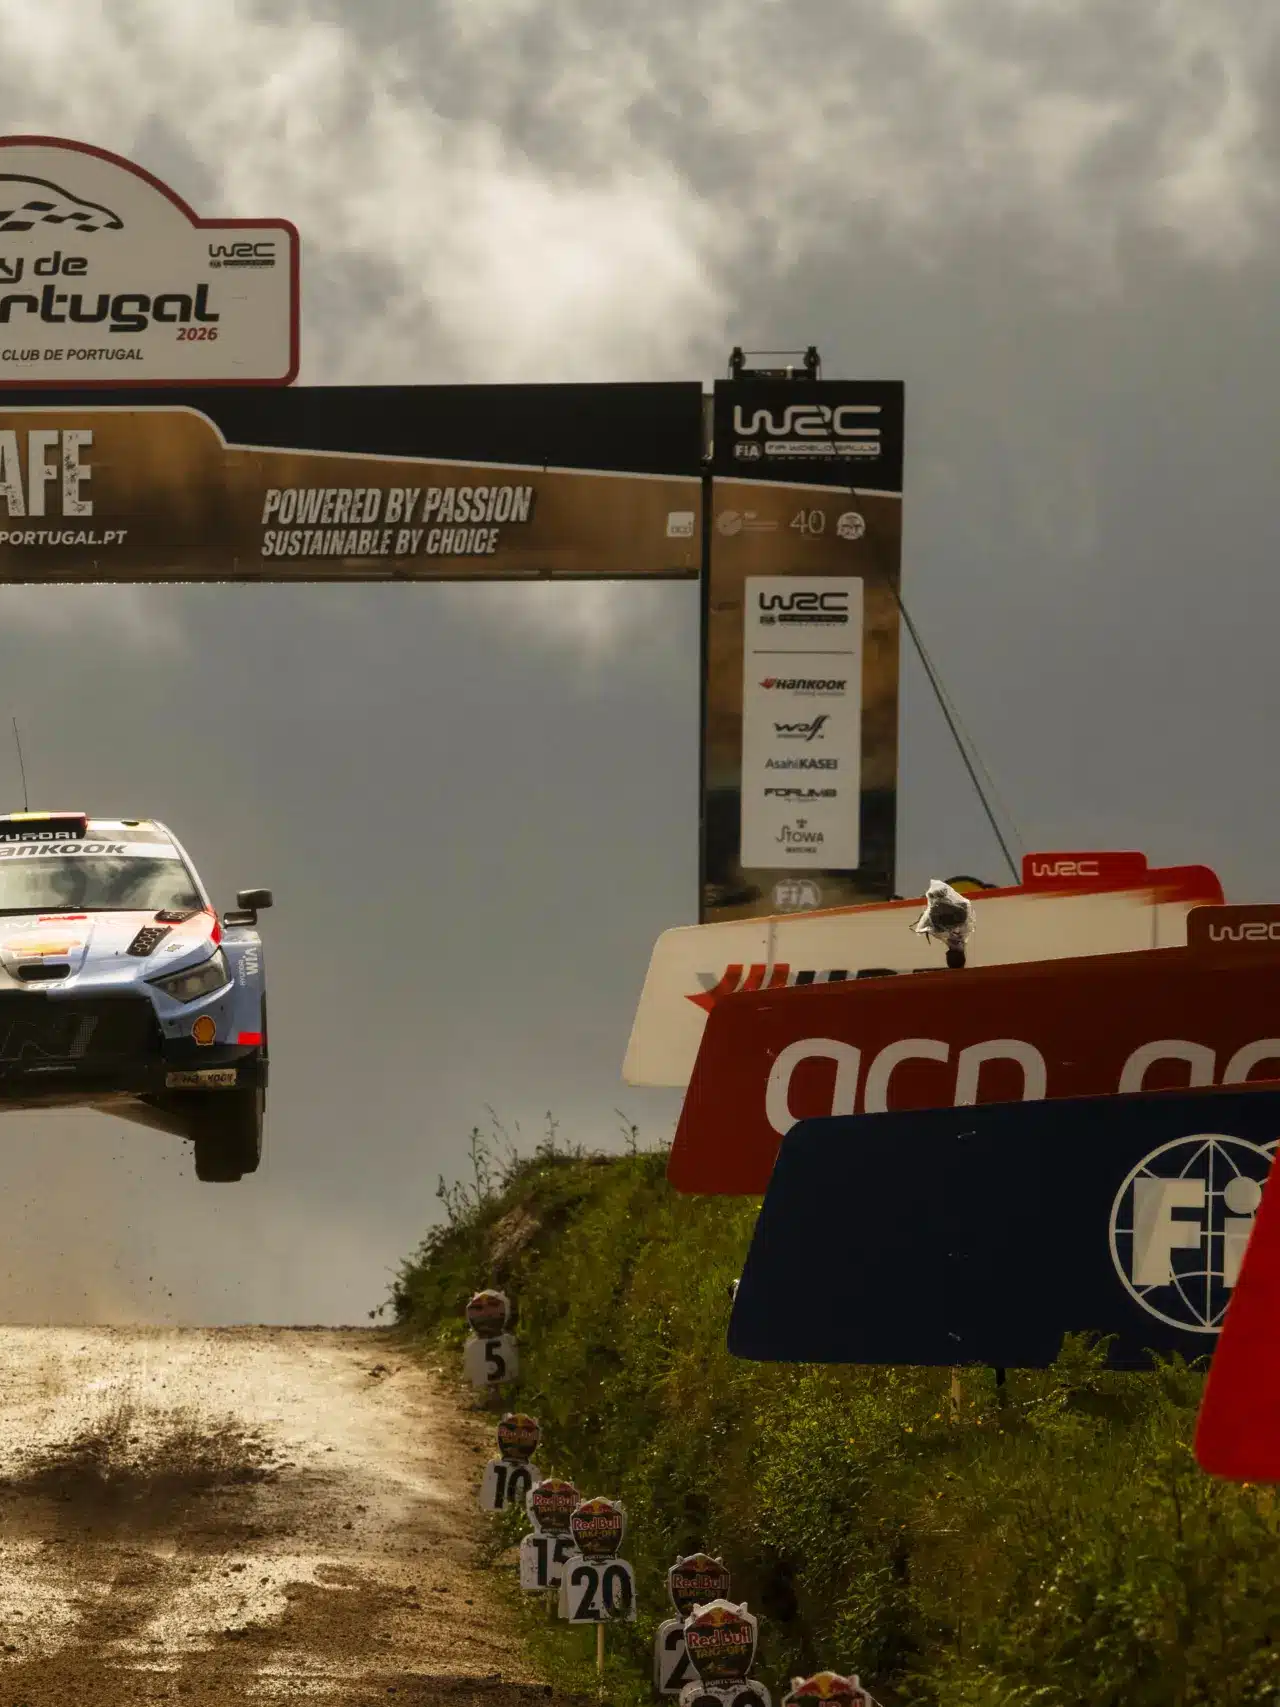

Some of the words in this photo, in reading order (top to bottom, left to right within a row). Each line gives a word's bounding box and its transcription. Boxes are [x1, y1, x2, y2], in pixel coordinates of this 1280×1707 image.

[34, 251, 88, 276] de
[176, 327, 218, 341] 2026
[1, 347, 43, 361] CLUB
[45, 348, 64, 360] DE
[66, 347, 145, 361] PORTUGAL
[733, 404, 882, 436] WRC
[261, 488, 382, 524] POWERED
[384, 488, 421, 524] BY
[422, 486, 533, 523] PASSION
[789, 509, 826, 534] 40
[261, 529, 393, 556] SUSTAINABLE
[394, 529, 424, 555] BY
[426, 528, 499, 555] CHOICE
[759, 592, 849, 611] WRC
[1032, 861, 1099, 876] WRC
[485, 1340, 506, 1381] 5
[572, 1515, 598, 1531] Red
[598, 1515, 622, 1530] Bull
[571, 1564, 633, 1620] 20
[672, 1573, 700, 1589] Red
[701, 1574, 729, 1590] Bull
[687, 1629, 721, 1647] Red
[720, 1626, 753, 1646] Bull
[665, 1629, 700, 1689] 2
